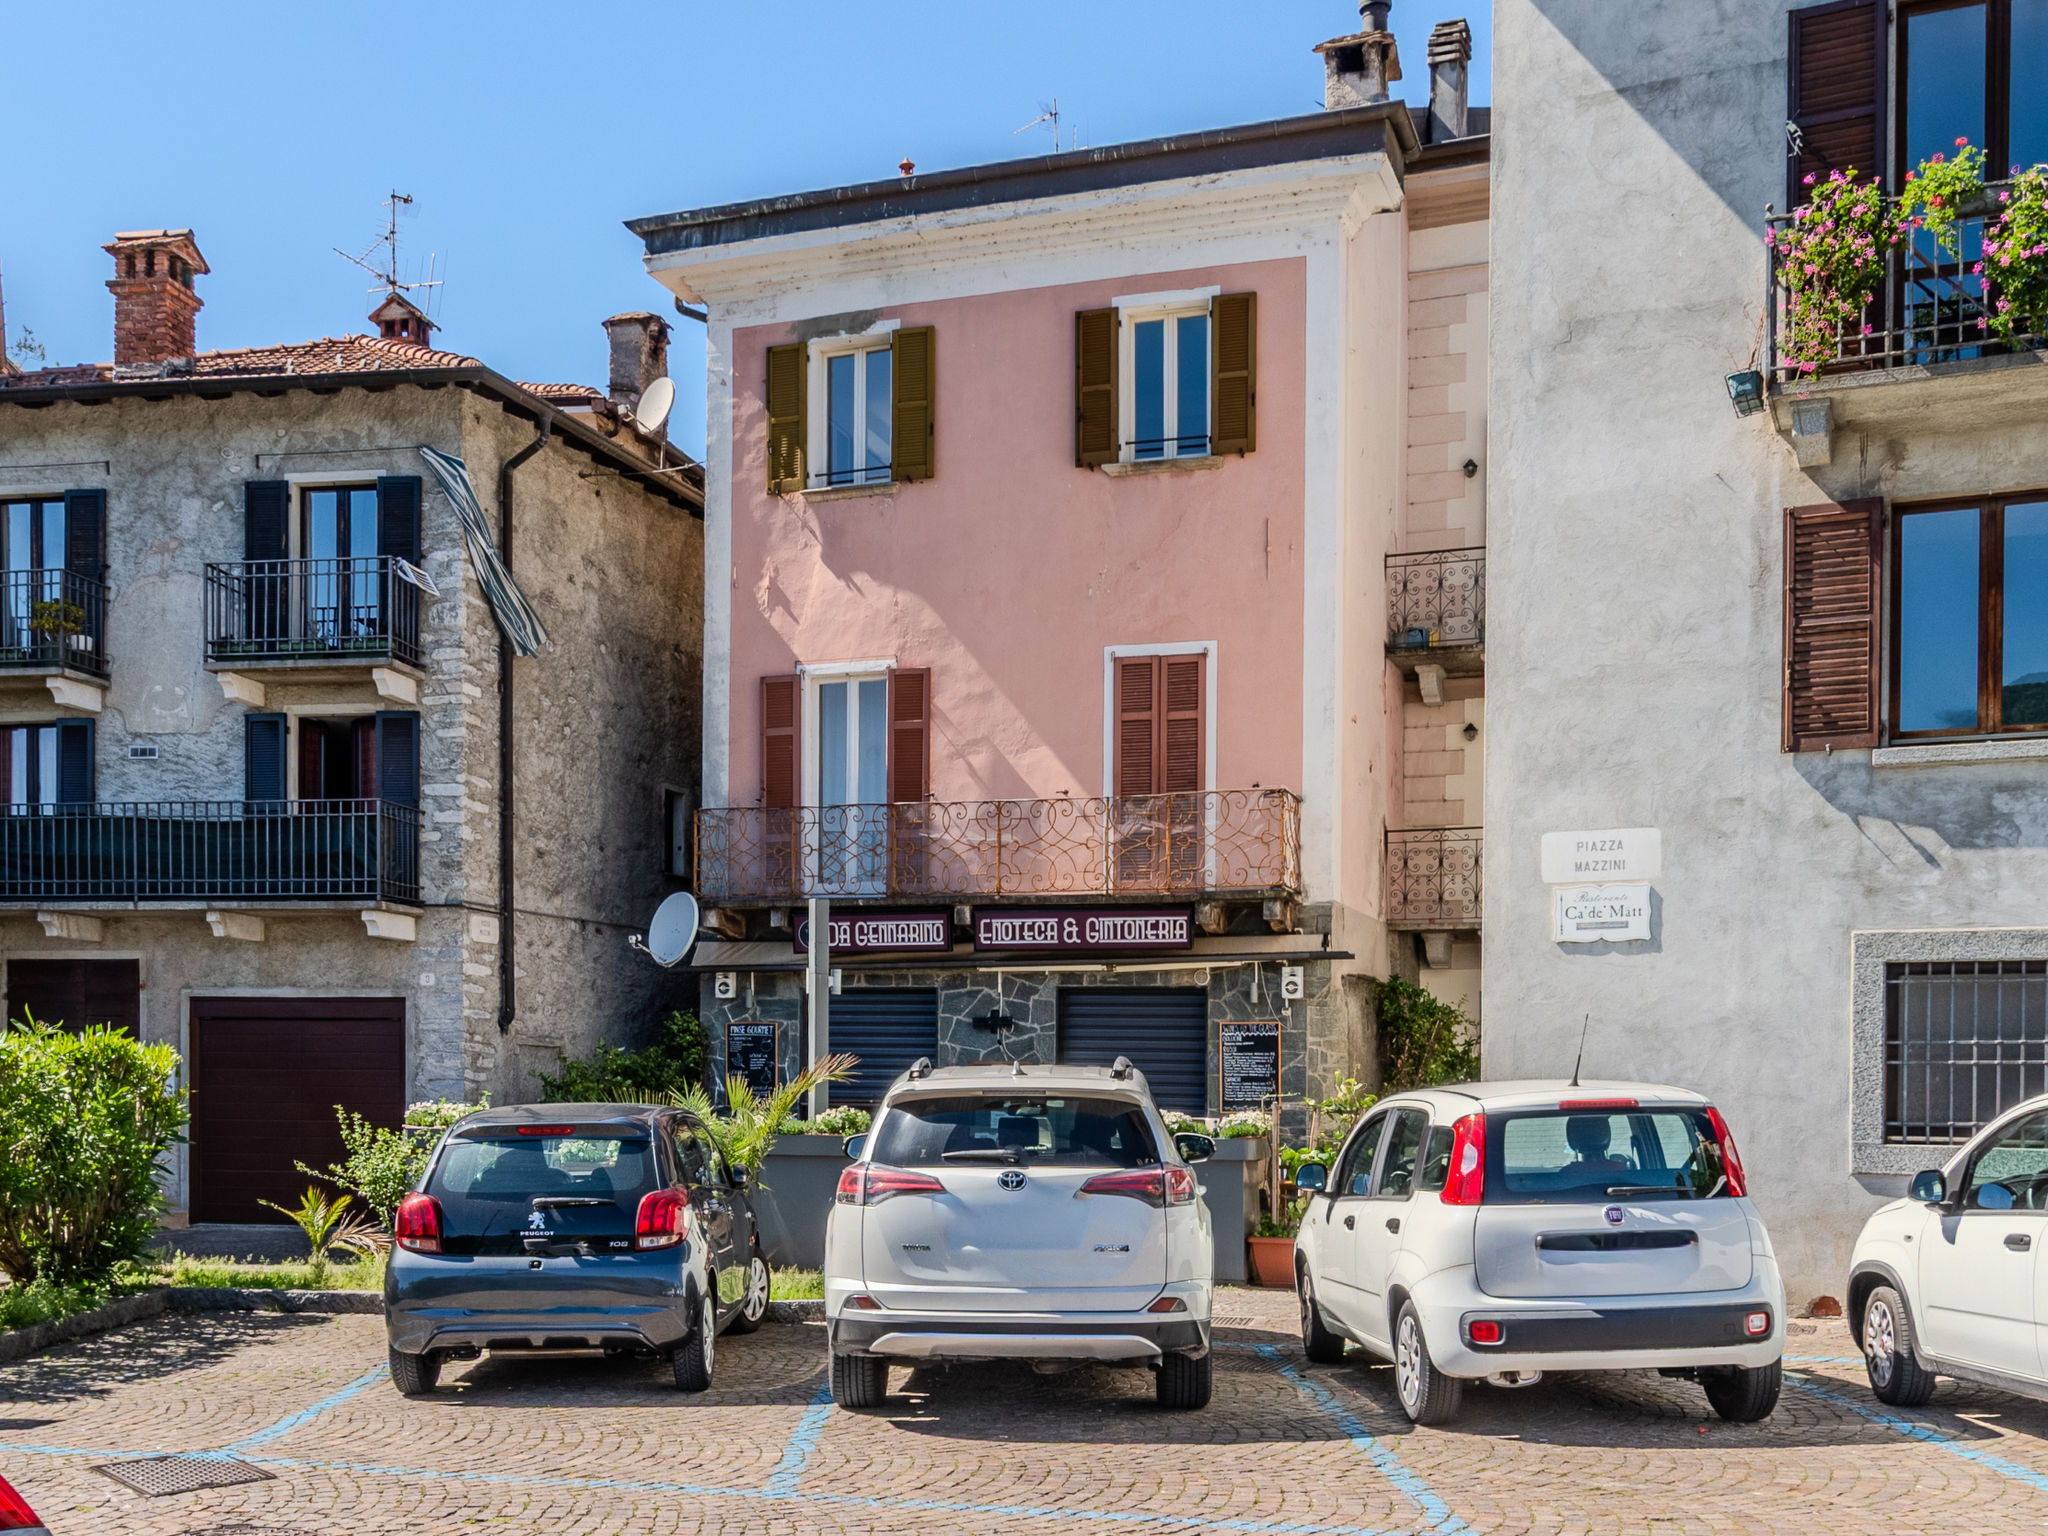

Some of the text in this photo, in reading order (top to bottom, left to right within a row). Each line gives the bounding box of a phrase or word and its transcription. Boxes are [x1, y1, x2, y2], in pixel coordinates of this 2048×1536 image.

[1577, 840, 1624, 852] PIAZZA
[1575, 860, 1626, 872] MAZZINI
[1610, 905, 1642, 918] Matt
[855, 920, 945, 947] GENNARINO
[979, 916, 1188, 944] ENOTECA & GINTONERIA
